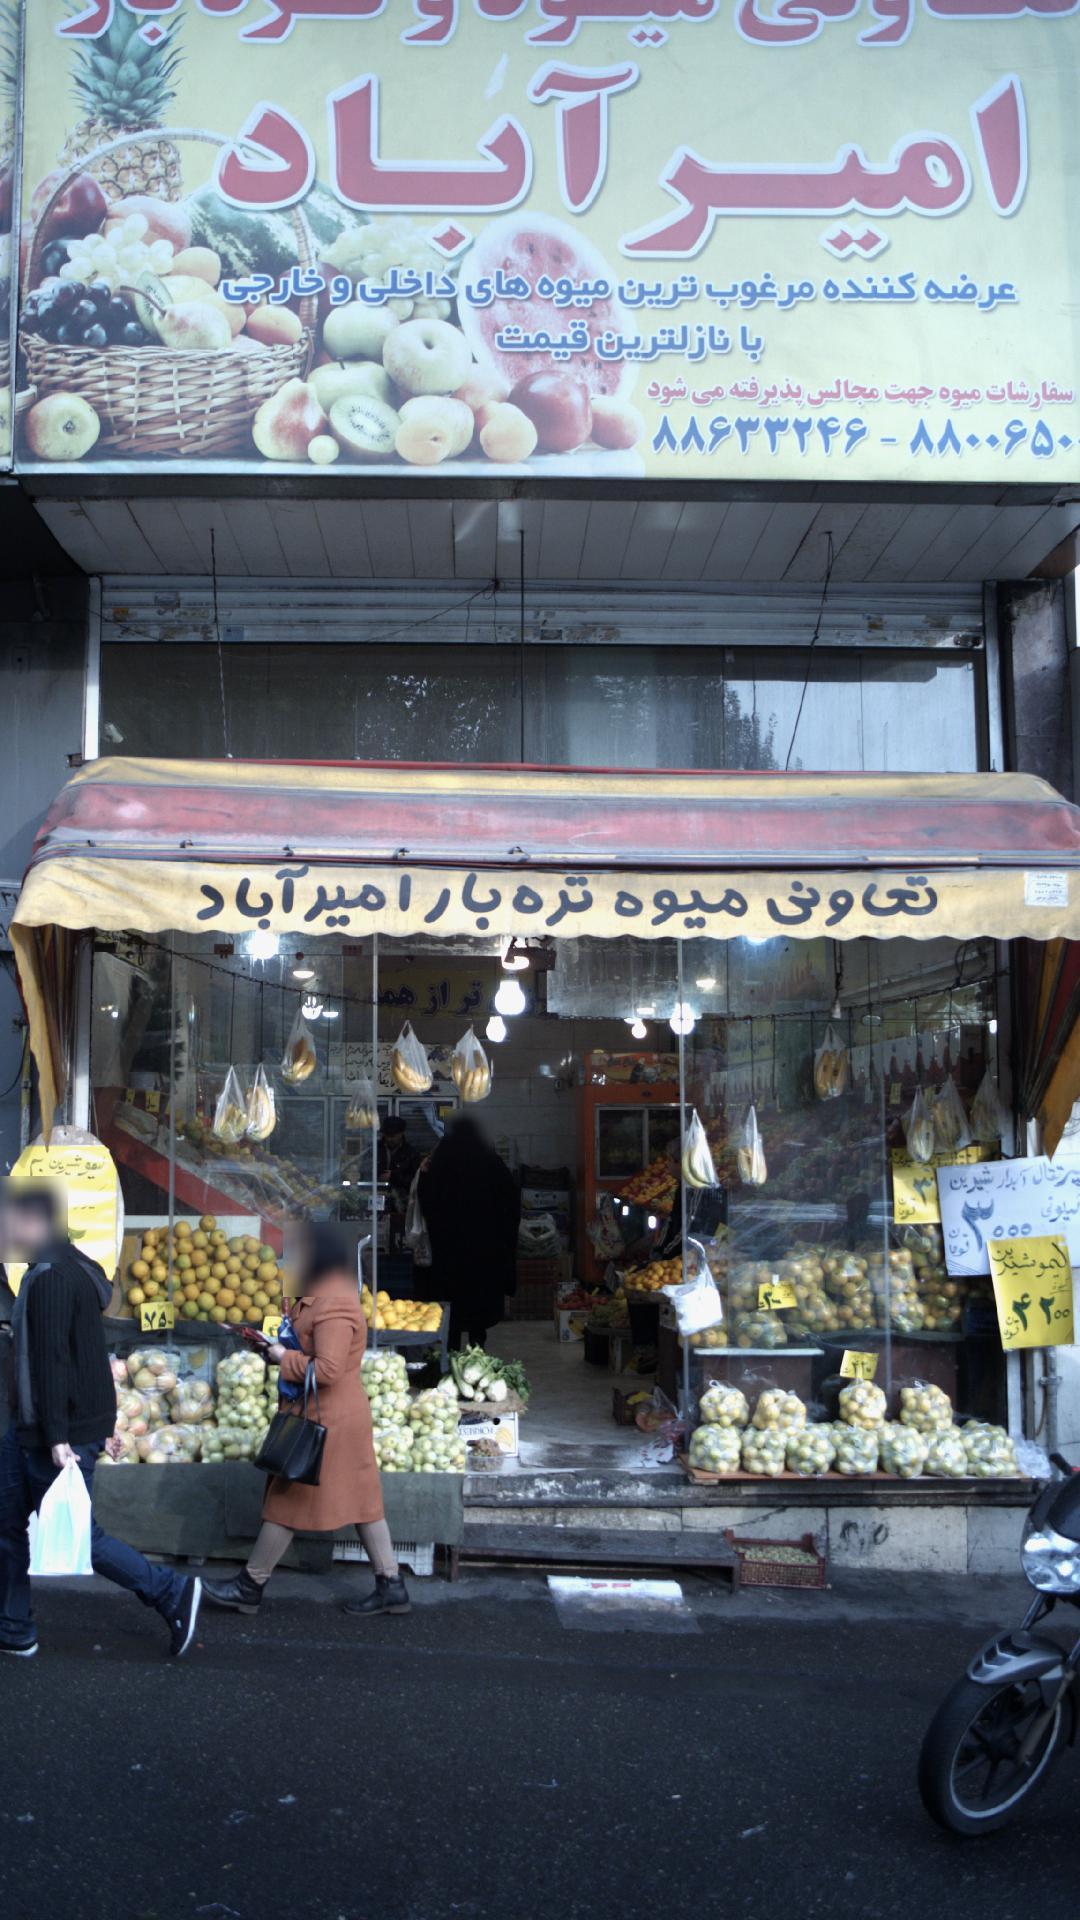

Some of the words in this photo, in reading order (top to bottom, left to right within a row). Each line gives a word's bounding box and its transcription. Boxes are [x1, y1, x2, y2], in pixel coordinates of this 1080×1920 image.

[222, 266, 325, 303] خارجی
[330, 276, 352, 304] و
[359, 268, 456, 304] داخلی
[466, 270, 530, 304] های
[538, 278, 610, 306] میوه
[618, 274, 699, 307] ترین
[706, 273, 815, 308] مرغوب
[823, 271, 914, 301] کننده
[924, 273, 1016, 308] عرضه
[495, 319, 590, 354] قیمت
[596, 324, 730, 360] نازلترین
[738, 326, 764, 361] با
[647, 377, 687, 407] شود
[691, 386, 725, 405] می
[729, 378, 802, 407] پذیرفته
[806, 379, 880, 407] مجالس
[884, 381, 934, 405] جهت
[938, 386, 981, 407] میوه
[986, 380, 1074, 409] سفارشات
[652, 415, 868, 455] ۸۸۶۳۳۲۴۶
[909, 417, 1080, 457] ۸۸۰۰۶۵۰
[424, 872, 502, 930] بار
[512, 875, 593, 927] تره
[614, 888, 748, 929] میوه
[766, 875, 938, 928] تعاونی
